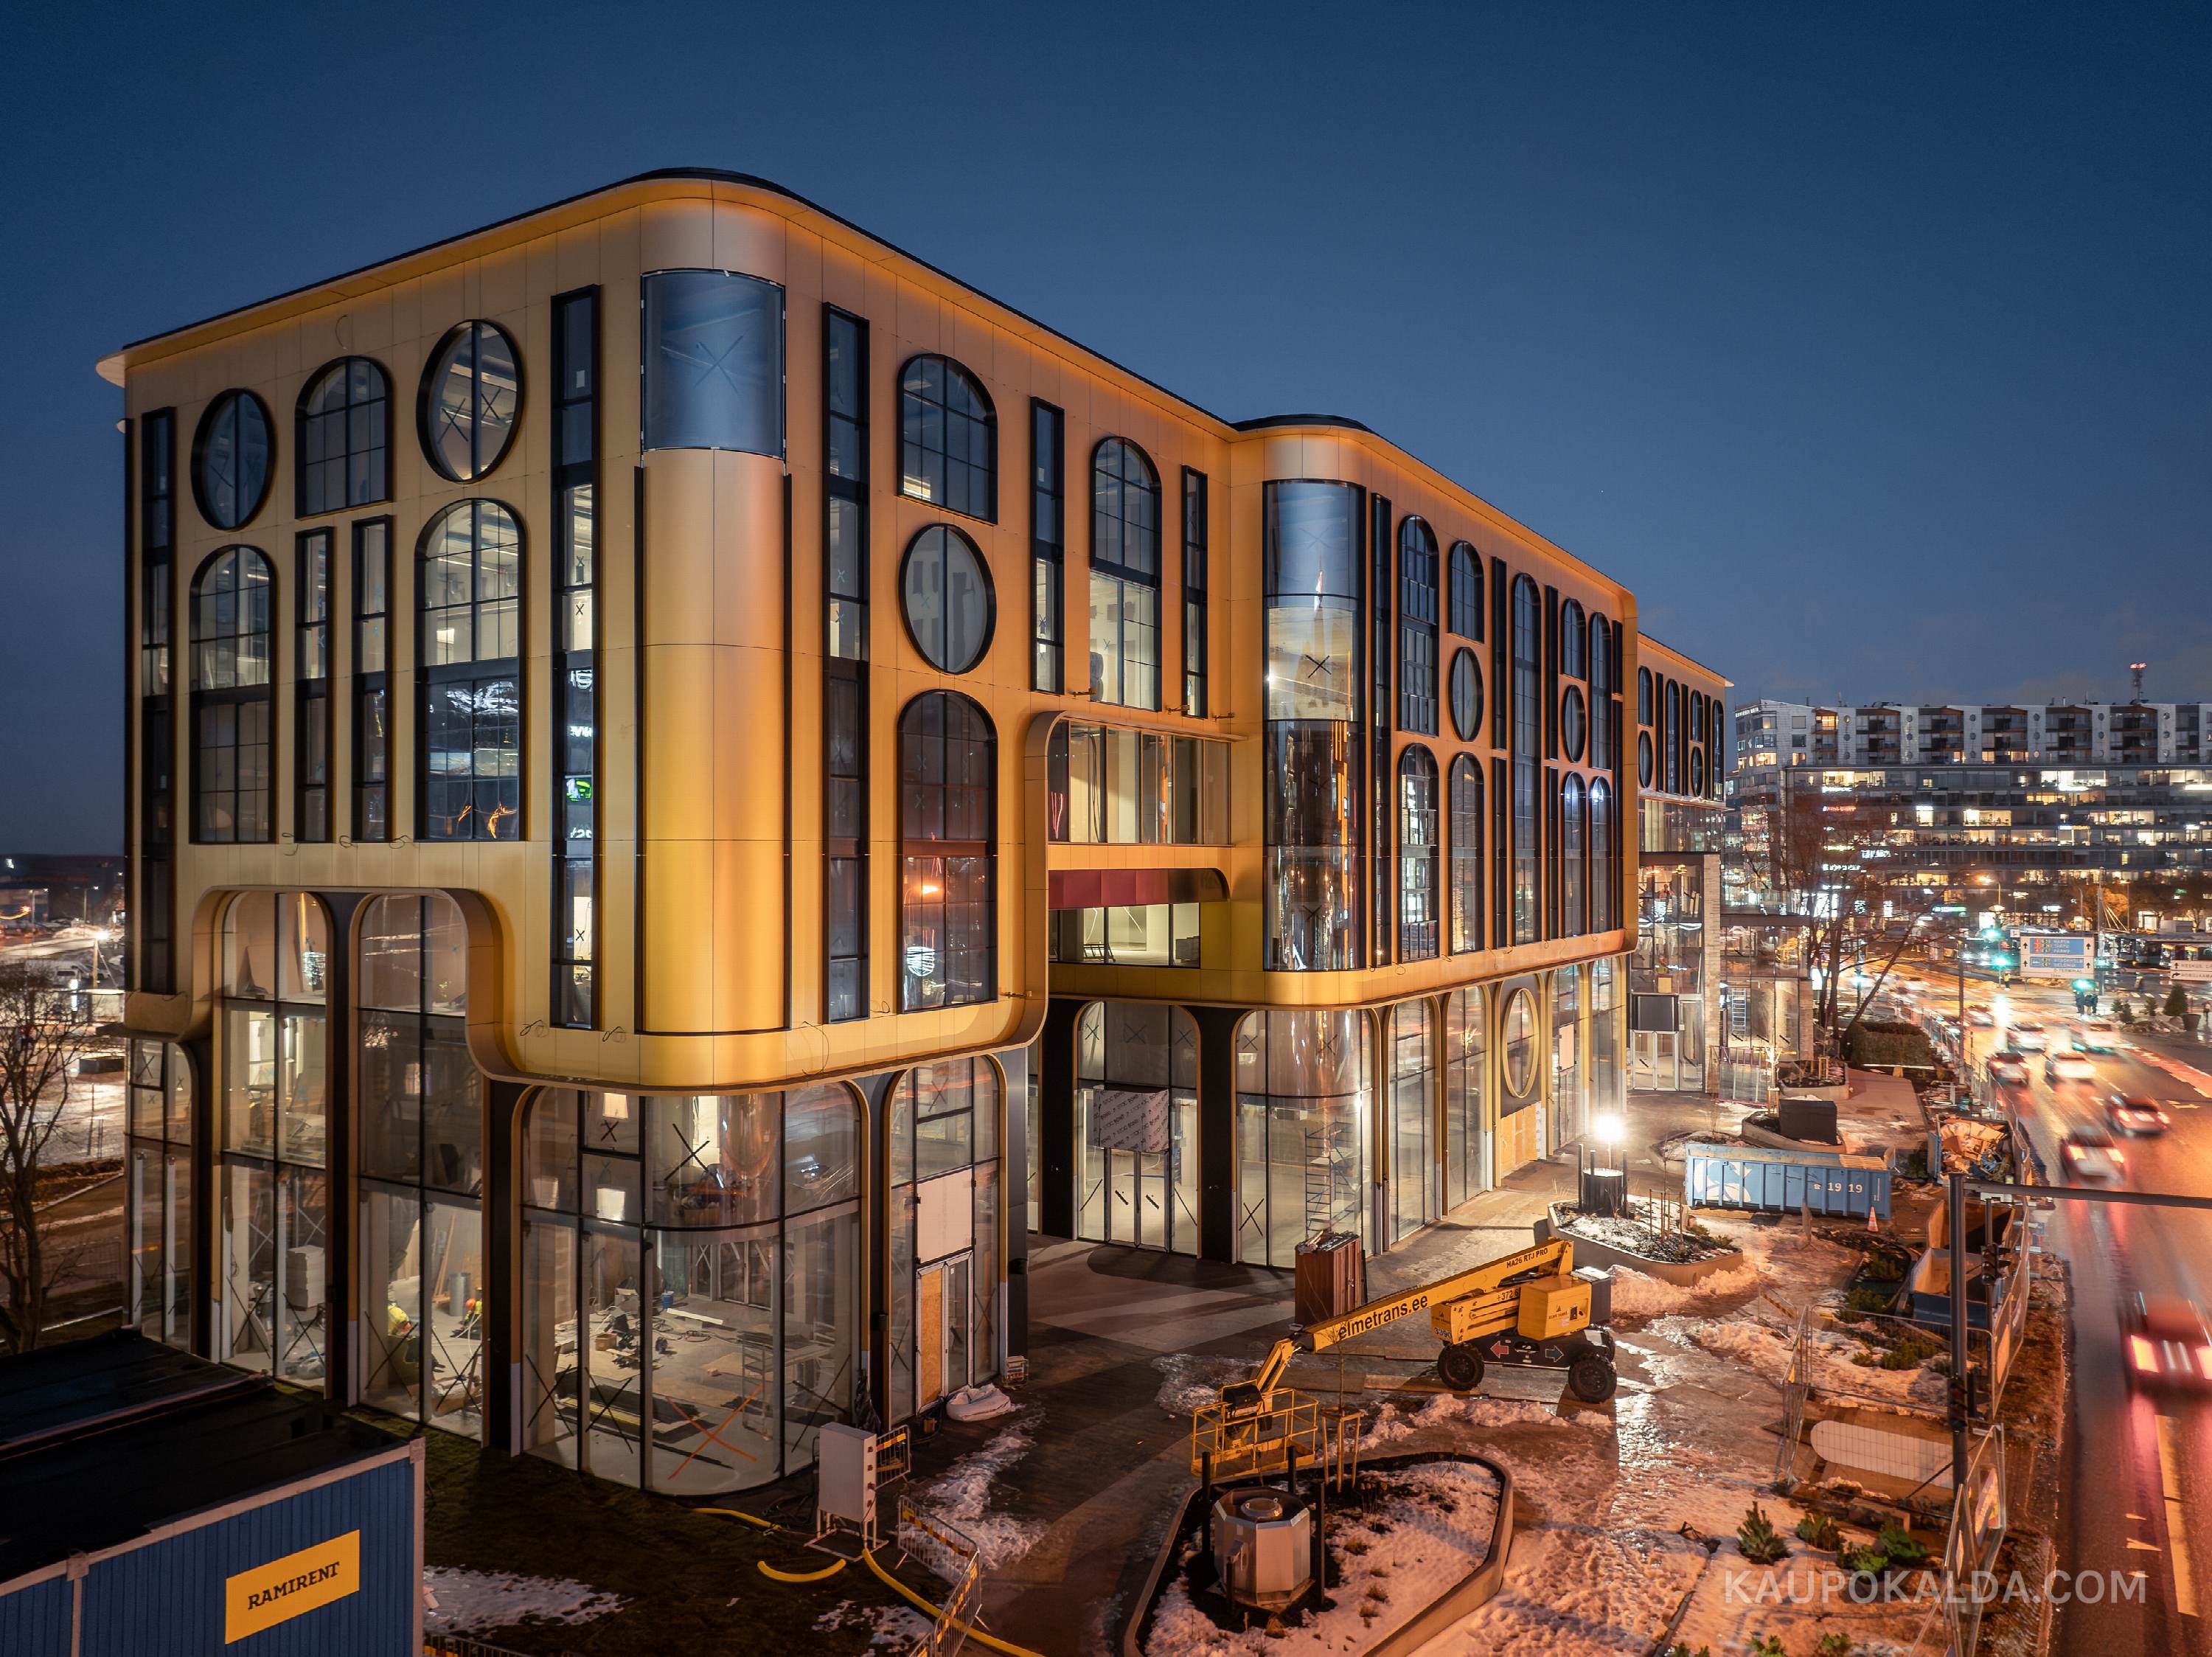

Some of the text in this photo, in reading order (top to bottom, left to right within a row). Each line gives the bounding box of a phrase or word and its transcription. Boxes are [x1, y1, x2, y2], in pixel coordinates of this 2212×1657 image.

[1828, 1182, 1863, 1193] 19 19
[1523, 1253, 1534, 1262] RTJ
[1536, 1247, 1548, 1258] PRO
[1497, 1290, 1513, 1301] +372
[1338, 1296, 1428, 1340] elmetrans.ee
[248, 1561, 340, 1610] RAMIRENT
